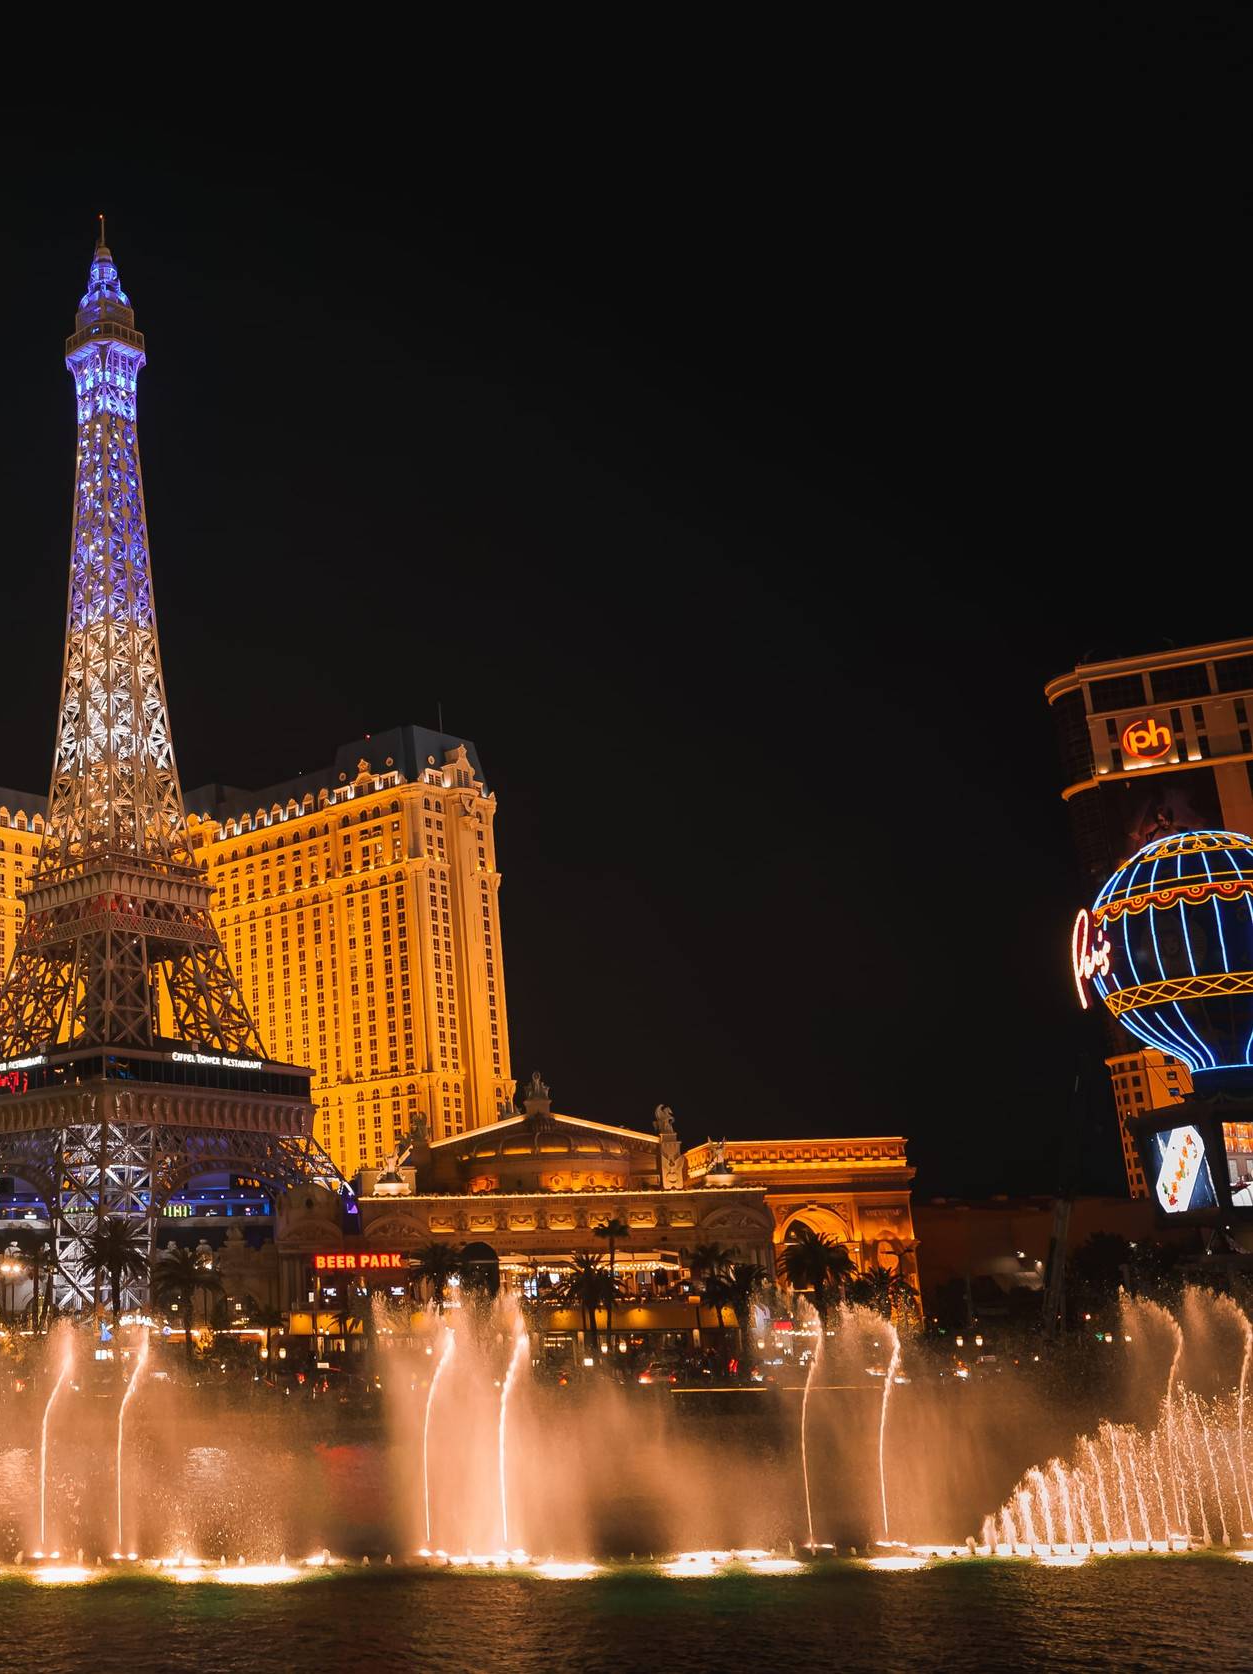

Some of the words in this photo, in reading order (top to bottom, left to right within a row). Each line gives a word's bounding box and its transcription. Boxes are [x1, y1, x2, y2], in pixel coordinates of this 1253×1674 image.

[1129, 719, 1172, 754] ph
[315, 1255, 356, 1269] BEER
[360, 1254, 402, 1268] PARK
